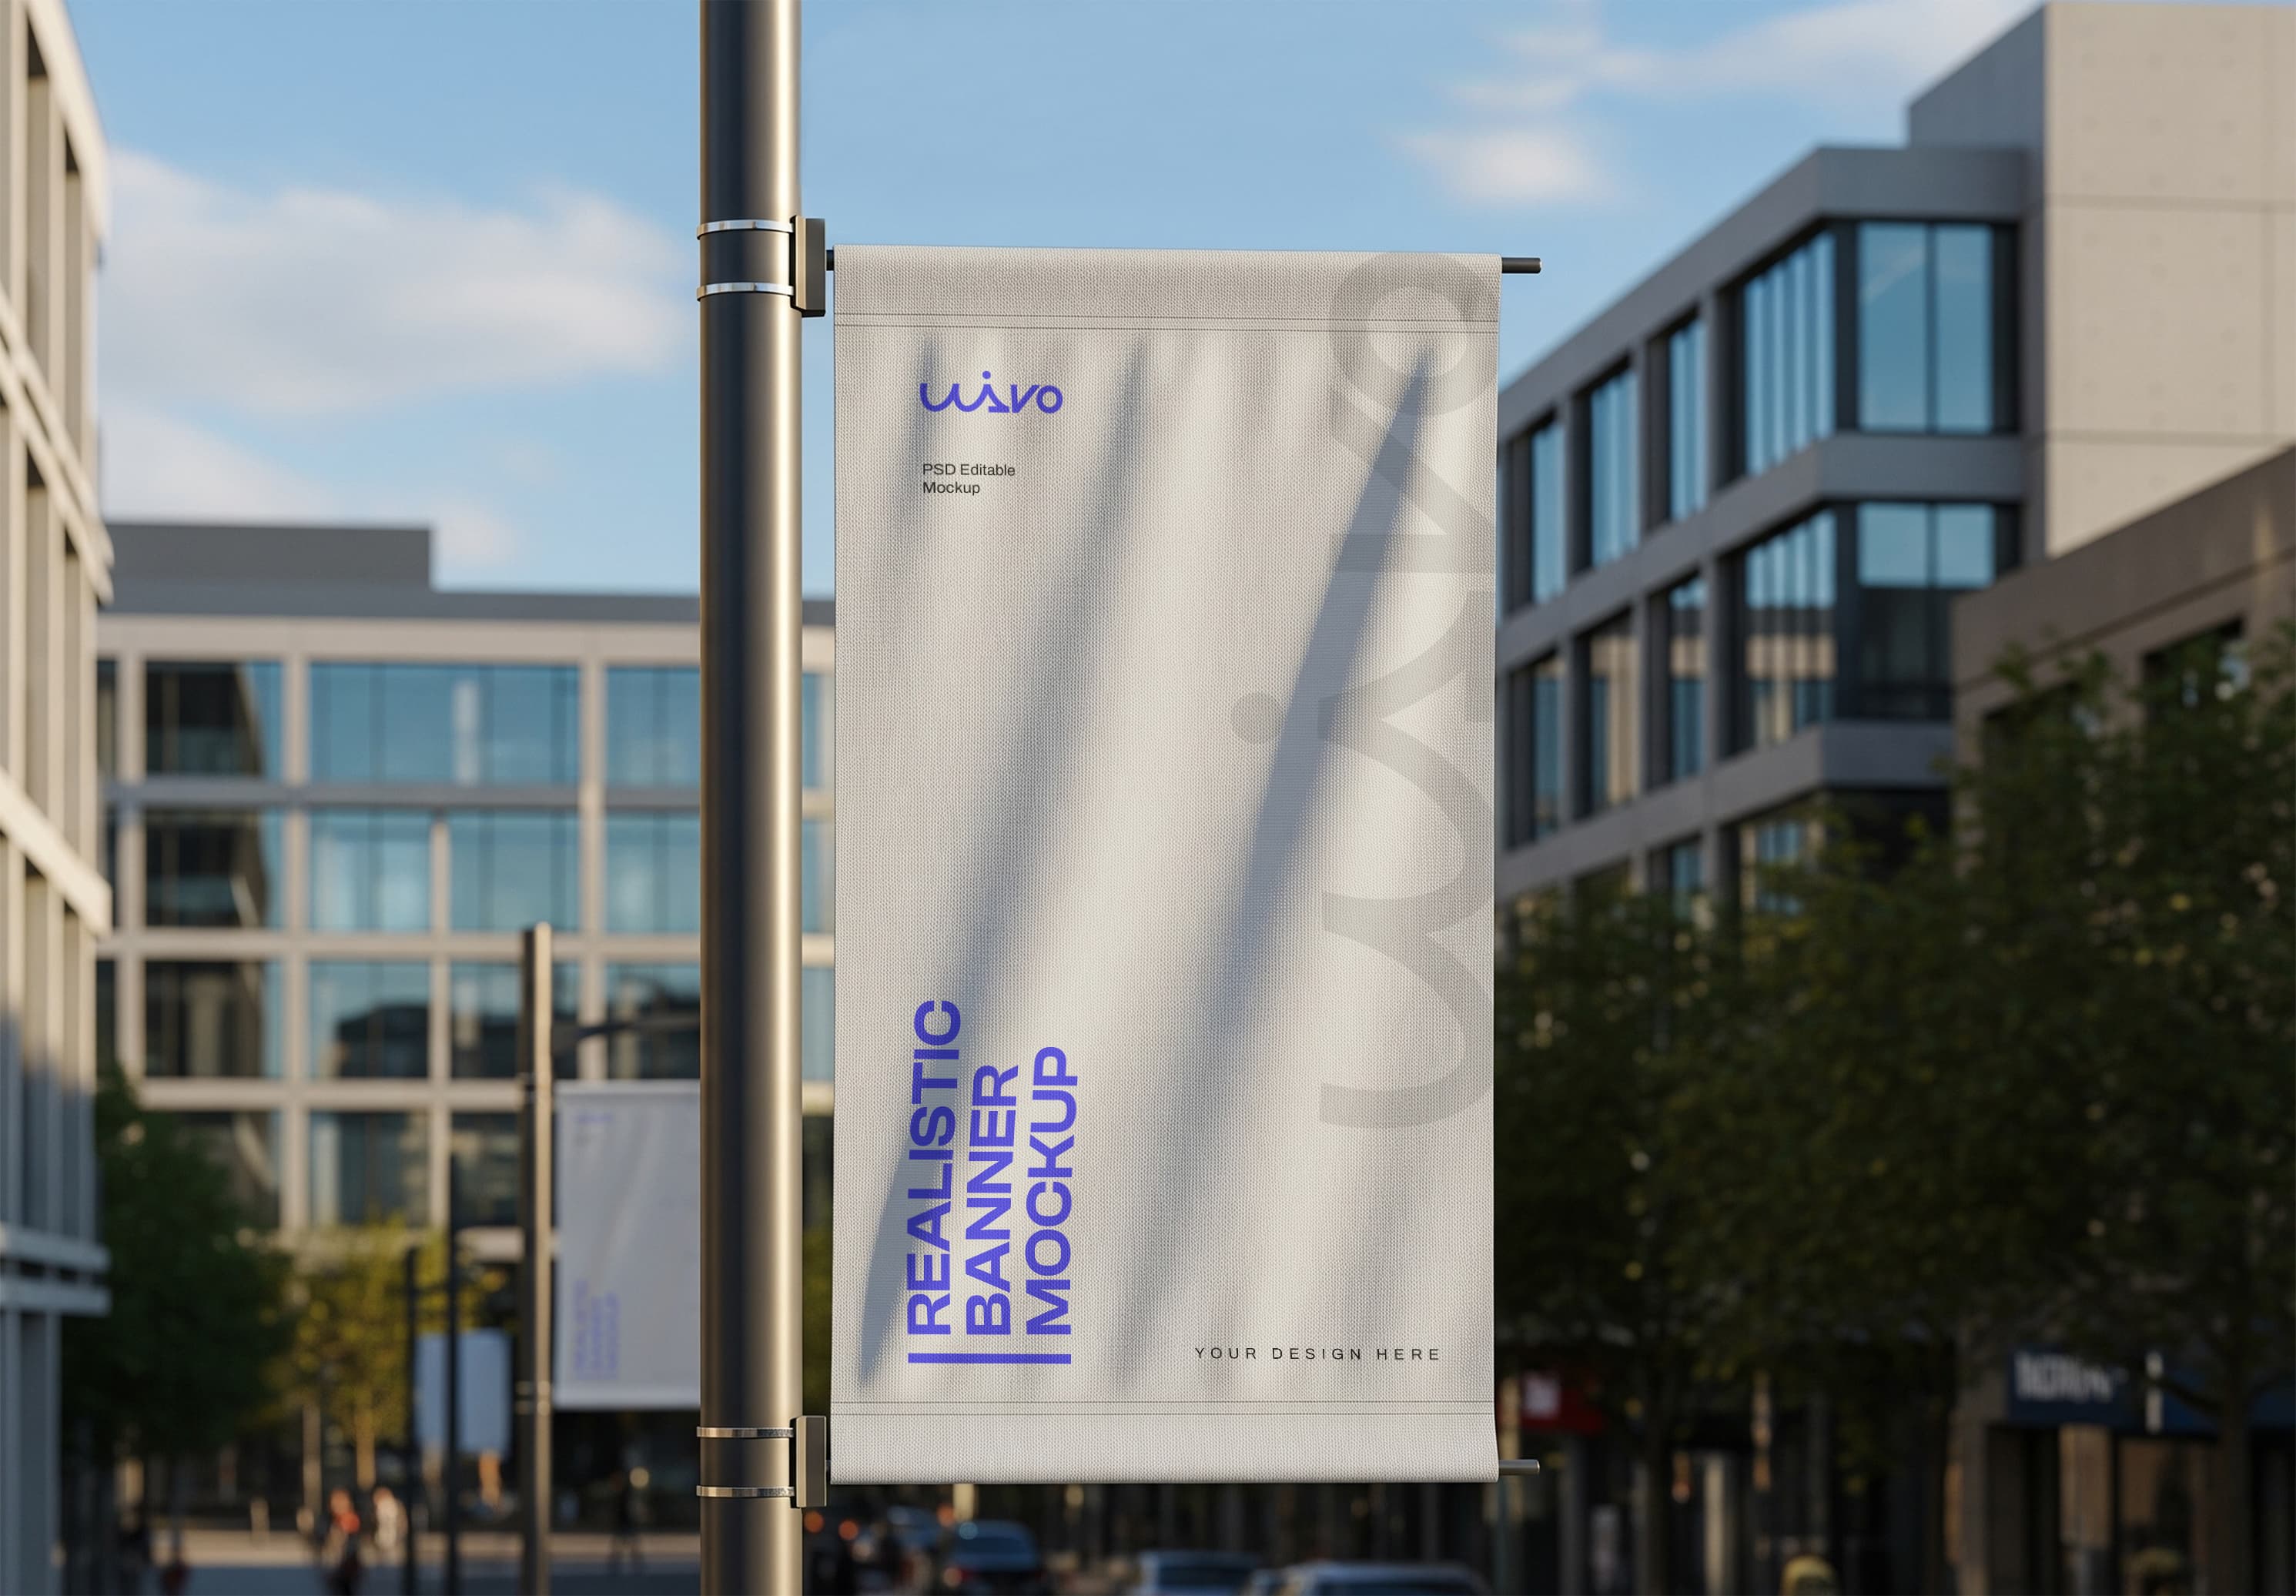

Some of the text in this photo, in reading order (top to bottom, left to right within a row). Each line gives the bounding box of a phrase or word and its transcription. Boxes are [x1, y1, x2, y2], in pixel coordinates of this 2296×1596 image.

[922, 463, 1016, 477] PSD Editable
[922, 481, 980, 496] Mockup
[906, 1000, 962, 1335] REALISTIC
[965, 1065, 1019, 1336] BANNER
[1025, 1046, 1079, 1335] MOCKUP
[1194, 1347, 1438, 1360] YOUR DESIGN HERE
